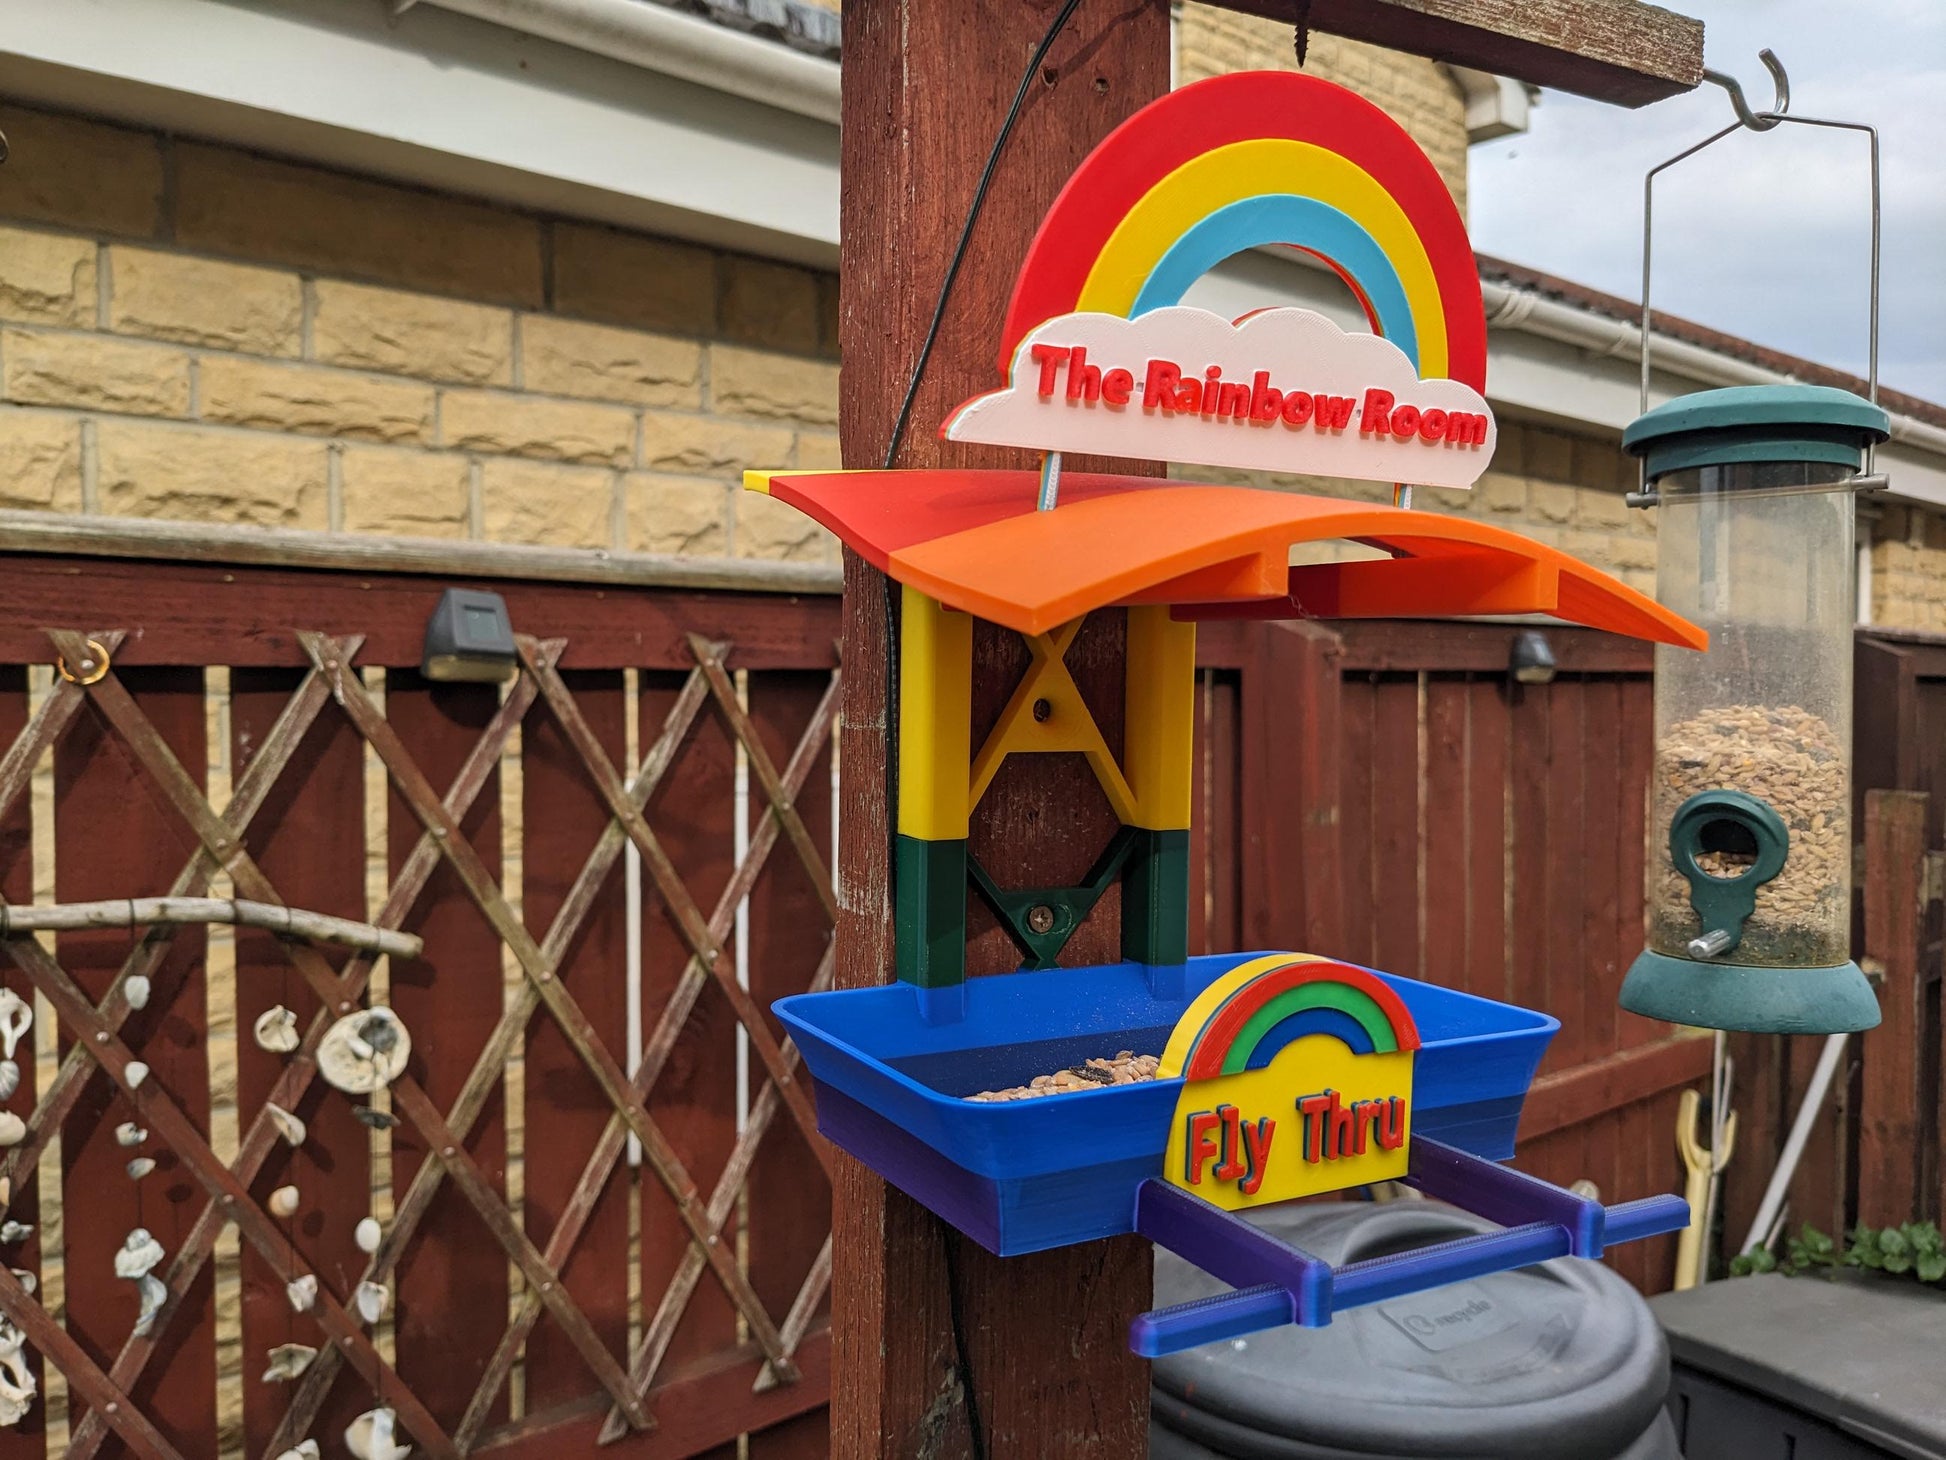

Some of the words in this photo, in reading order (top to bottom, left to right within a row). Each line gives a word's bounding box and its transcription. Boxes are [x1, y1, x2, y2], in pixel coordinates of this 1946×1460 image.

[1031, 344, 1134, 405] The
[1143, 359, 1356, 430] Rainbow
[1360, 387, 1488, 446] Room
[1185, 1104, 1276, 1195] Fly
[1296, 1088, 1405, 1164] Thru
